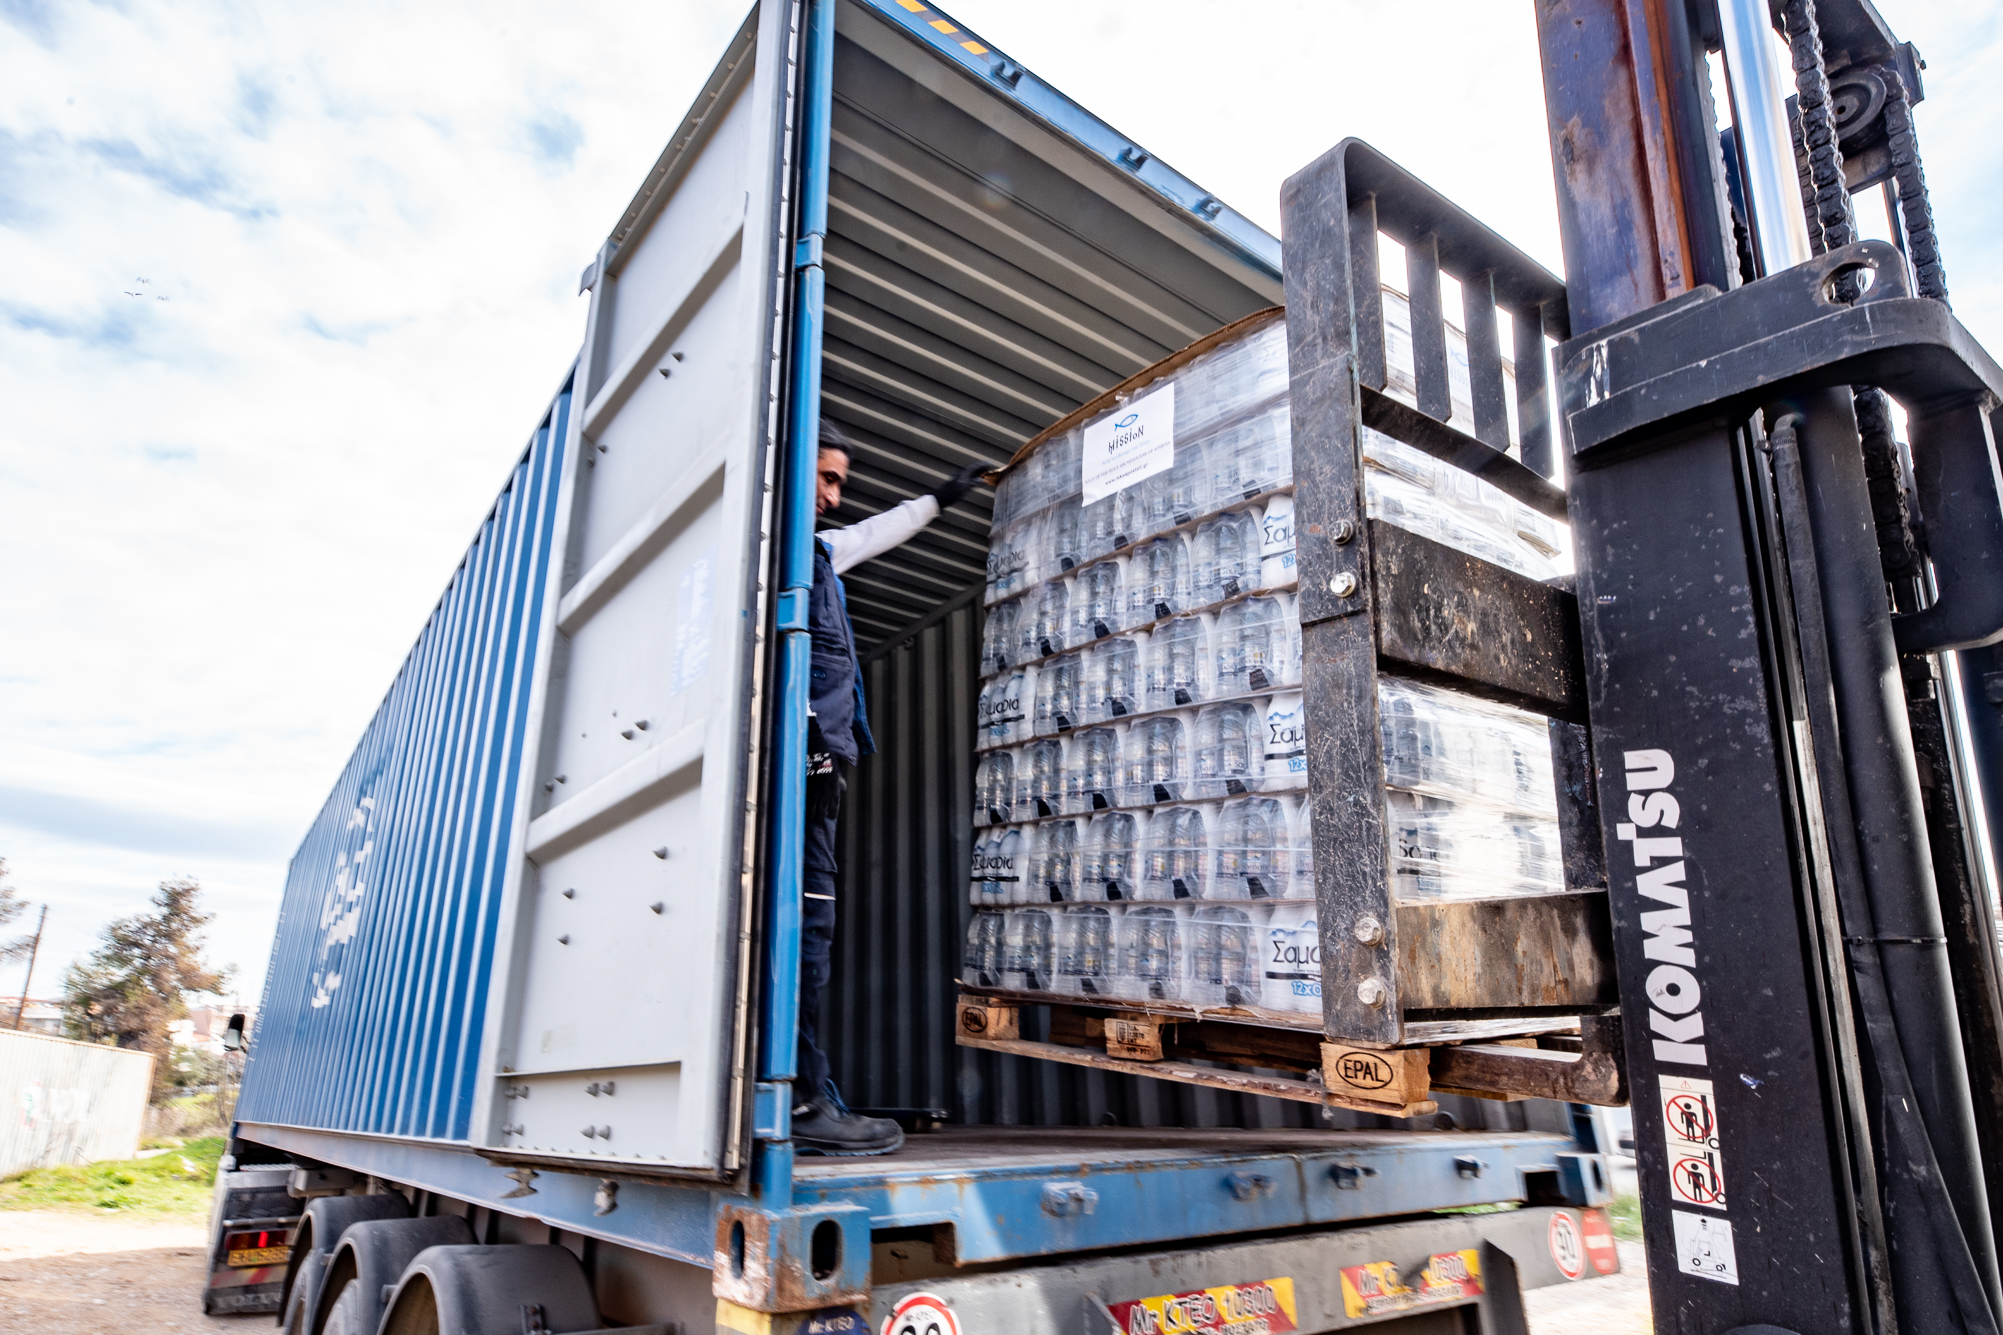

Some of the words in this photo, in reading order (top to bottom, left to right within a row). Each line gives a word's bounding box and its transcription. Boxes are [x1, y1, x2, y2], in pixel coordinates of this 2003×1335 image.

[1616, 748, 1707, 1066] KOMATSU
[1344, 1059, 1385, 1083] EPAL
[1129, 1304, 1160, 1335] Mr
[1222, 1285, 1279, 1321] 10300
